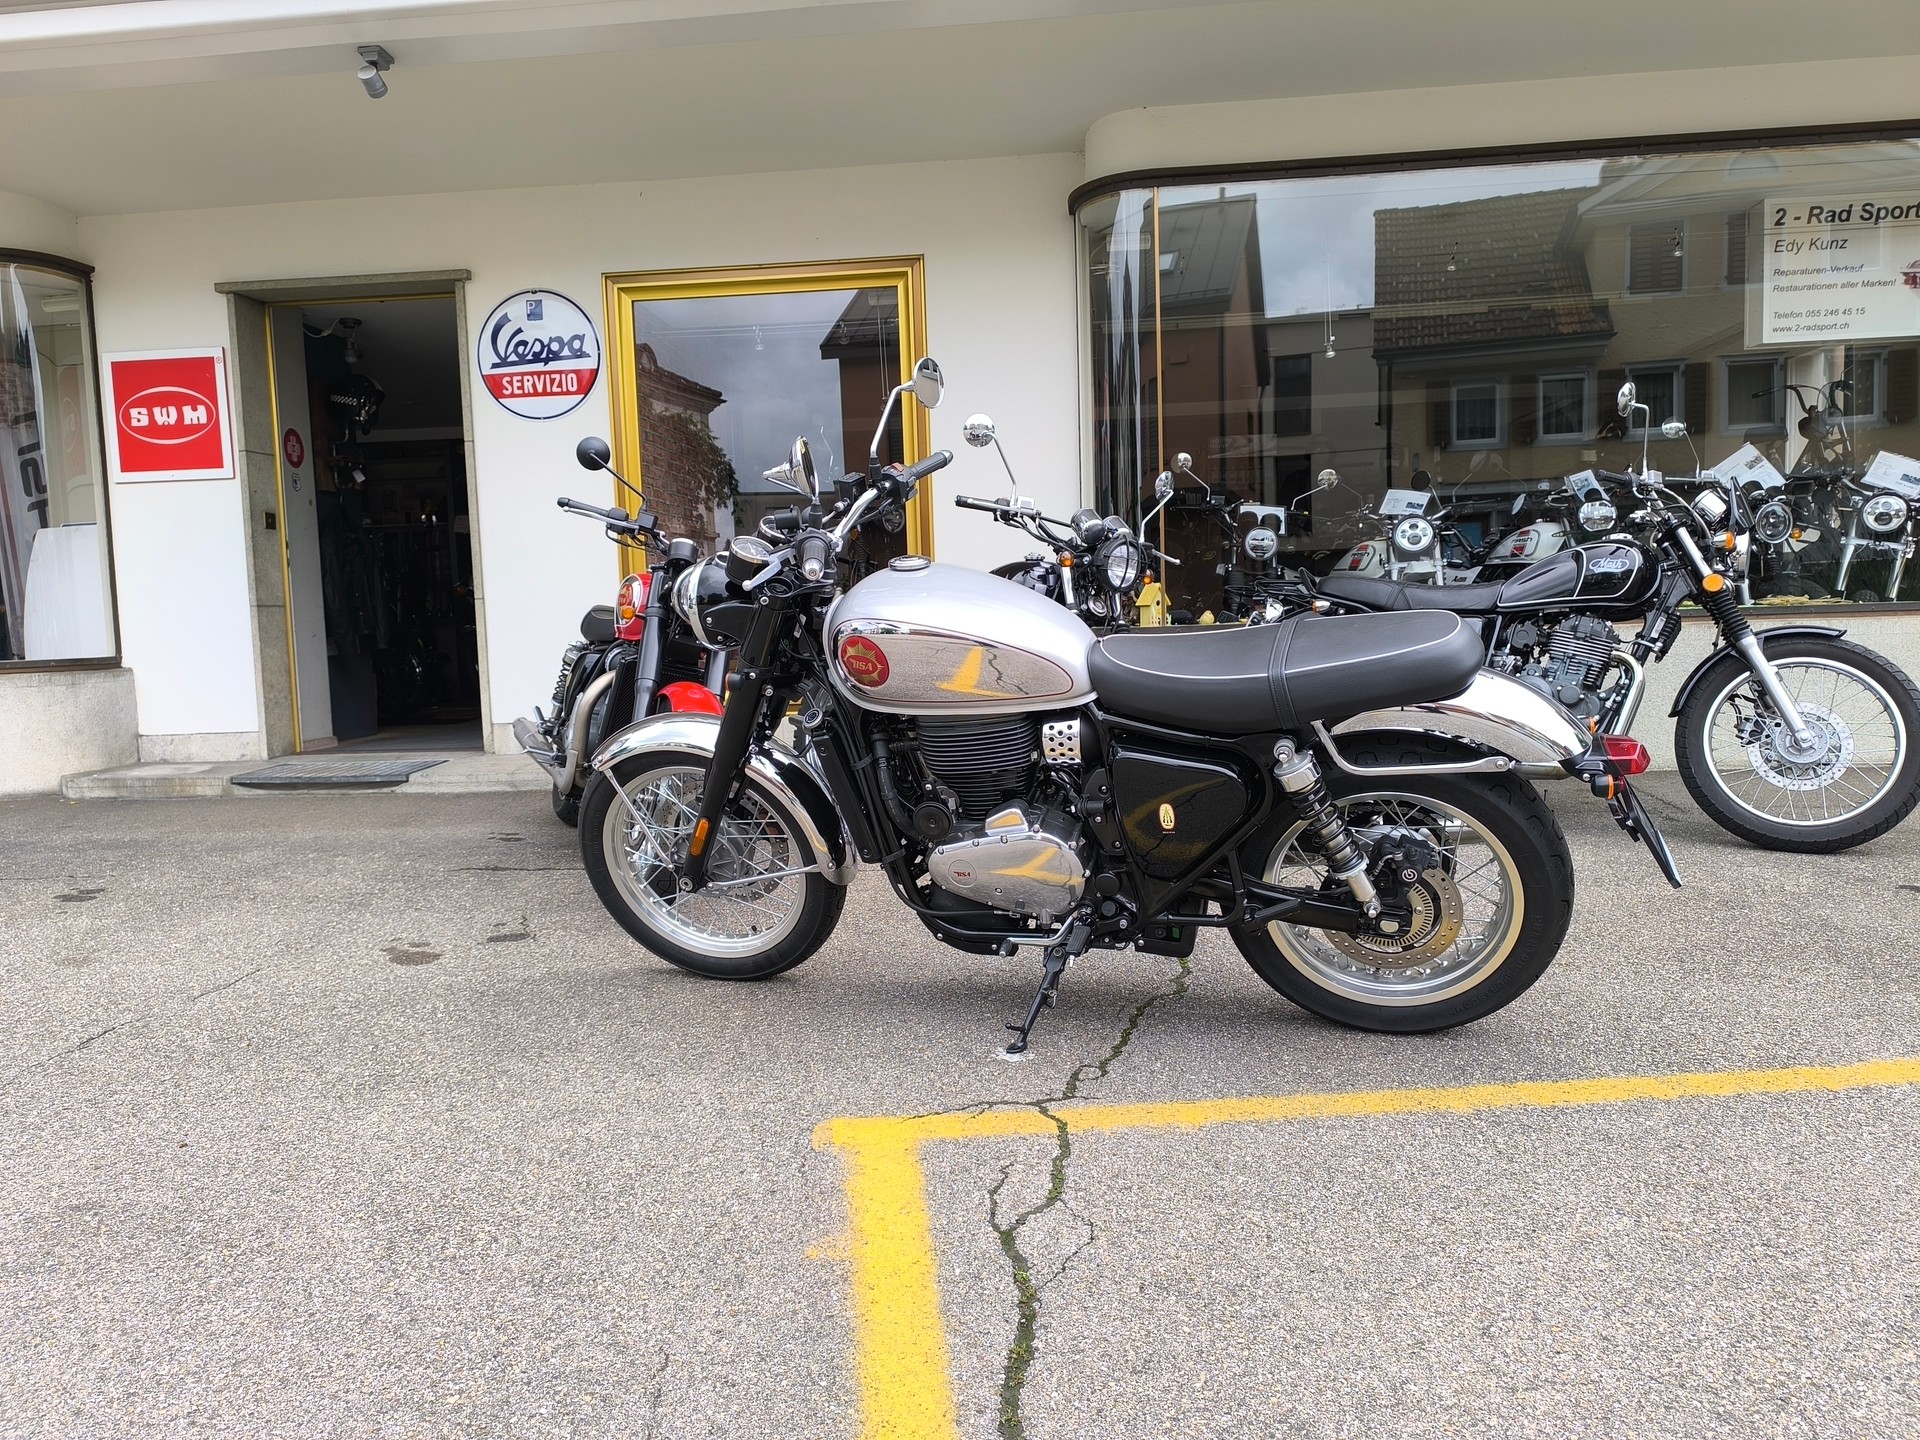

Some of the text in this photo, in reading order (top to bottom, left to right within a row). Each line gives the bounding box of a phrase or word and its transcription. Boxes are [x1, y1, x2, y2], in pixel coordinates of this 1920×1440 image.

[1774, 207, 1787, 227] 2
[1806, 203, 1854, 225] Rad
[1859, 202, 1920, 226] Sport
[1774, 237, 1849, 255] Edy Kunz
[1773, 264, 1864, 278] Reparaturen-Verkauf
[1772, 278, 1897, 293] Restaurationen aller Marken!
[1773, 306, 1866, 320] Telefon 055 246 45 15
[1772, 322, 1850, 333] www.2-radsport.ch
[490, 312, 591, 368] Vespa
[502, 373, 578, 395] SERVIZIO
[129, 404, 208, 427] SWM
[850, 658, 873, 671] BSA
